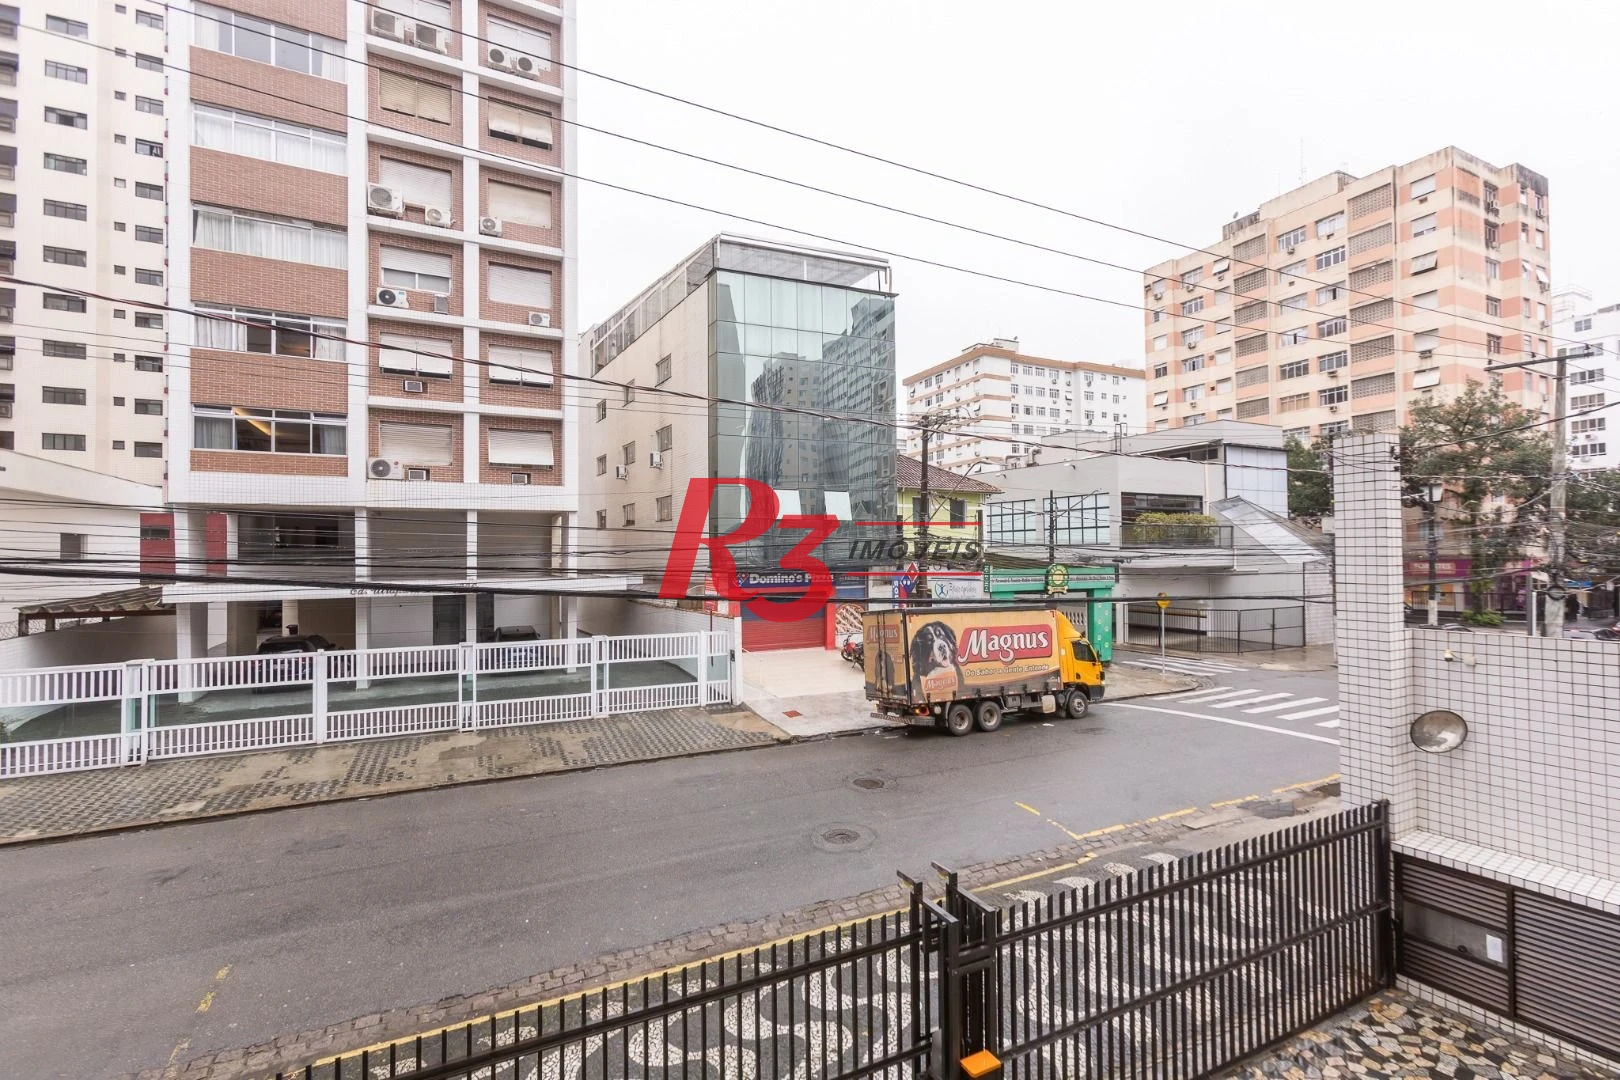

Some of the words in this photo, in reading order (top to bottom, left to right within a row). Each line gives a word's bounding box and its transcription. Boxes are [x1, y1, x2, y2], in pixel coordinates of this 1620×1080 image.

[749, 573, 803, 584] Domino's
[957, 629, 1049, 663] Magnus
[1024, 663, 1050, 672] Entende
